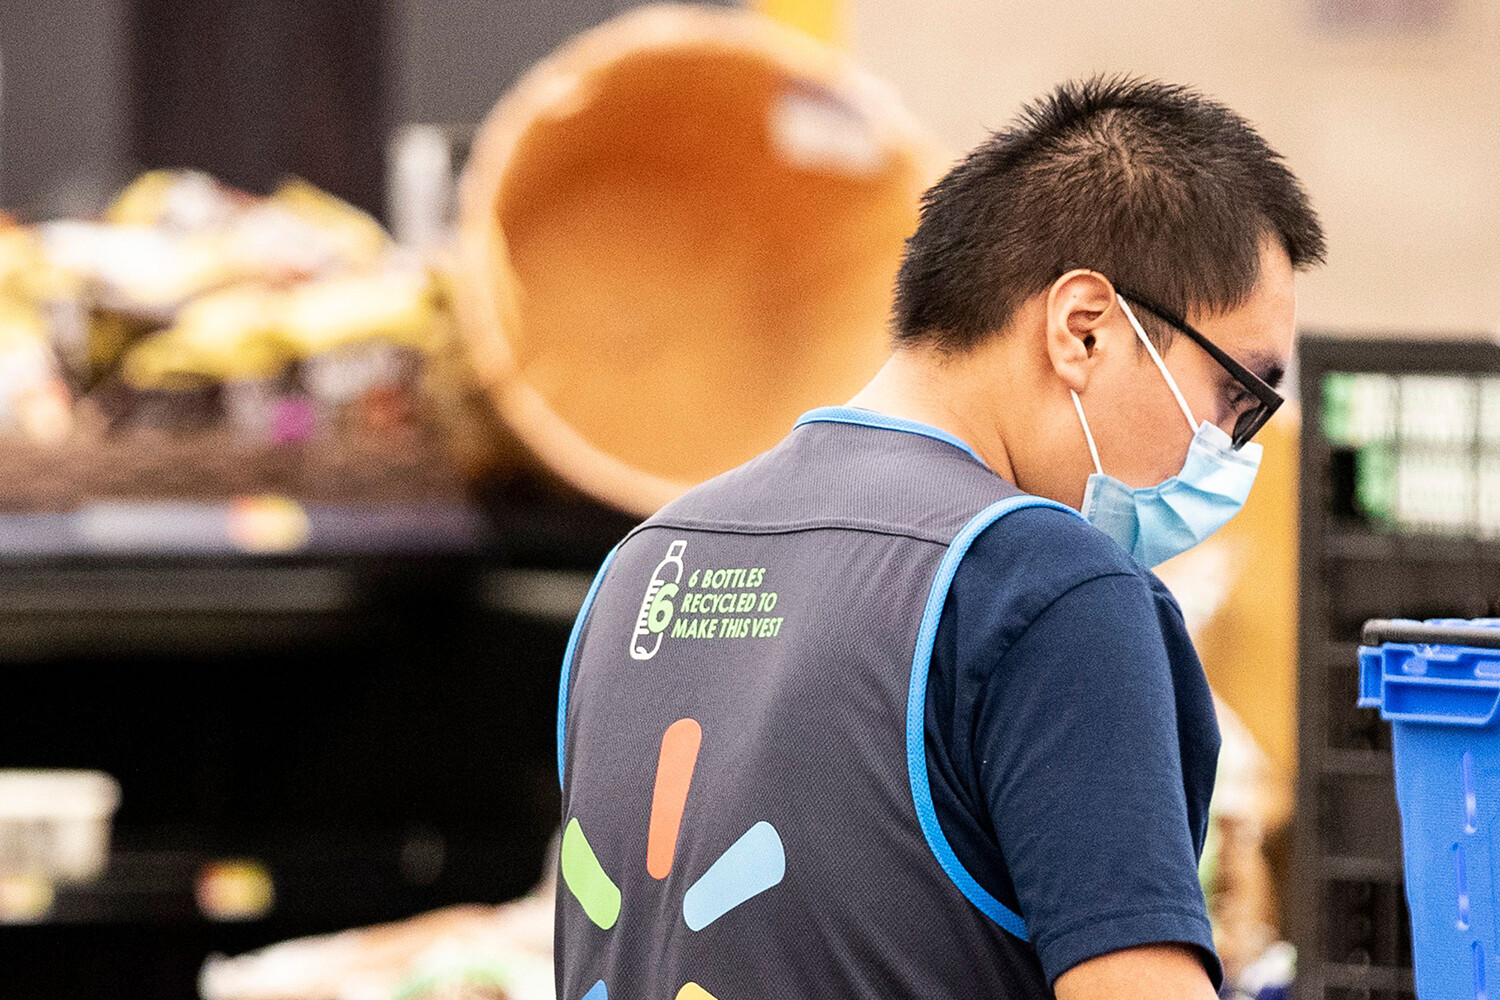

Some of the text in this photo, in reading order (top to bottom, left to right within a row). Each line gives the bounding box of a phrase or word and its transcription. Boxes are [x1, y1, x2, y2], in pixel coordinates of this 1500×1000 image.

[688, 567, 766, 588] 6 BOTTLES
[647, 583, 680, 634] 6
[680, 592, 777, 614] RECYCLED TO
[671, 617, 784, 639] MAKE THIS VEST
